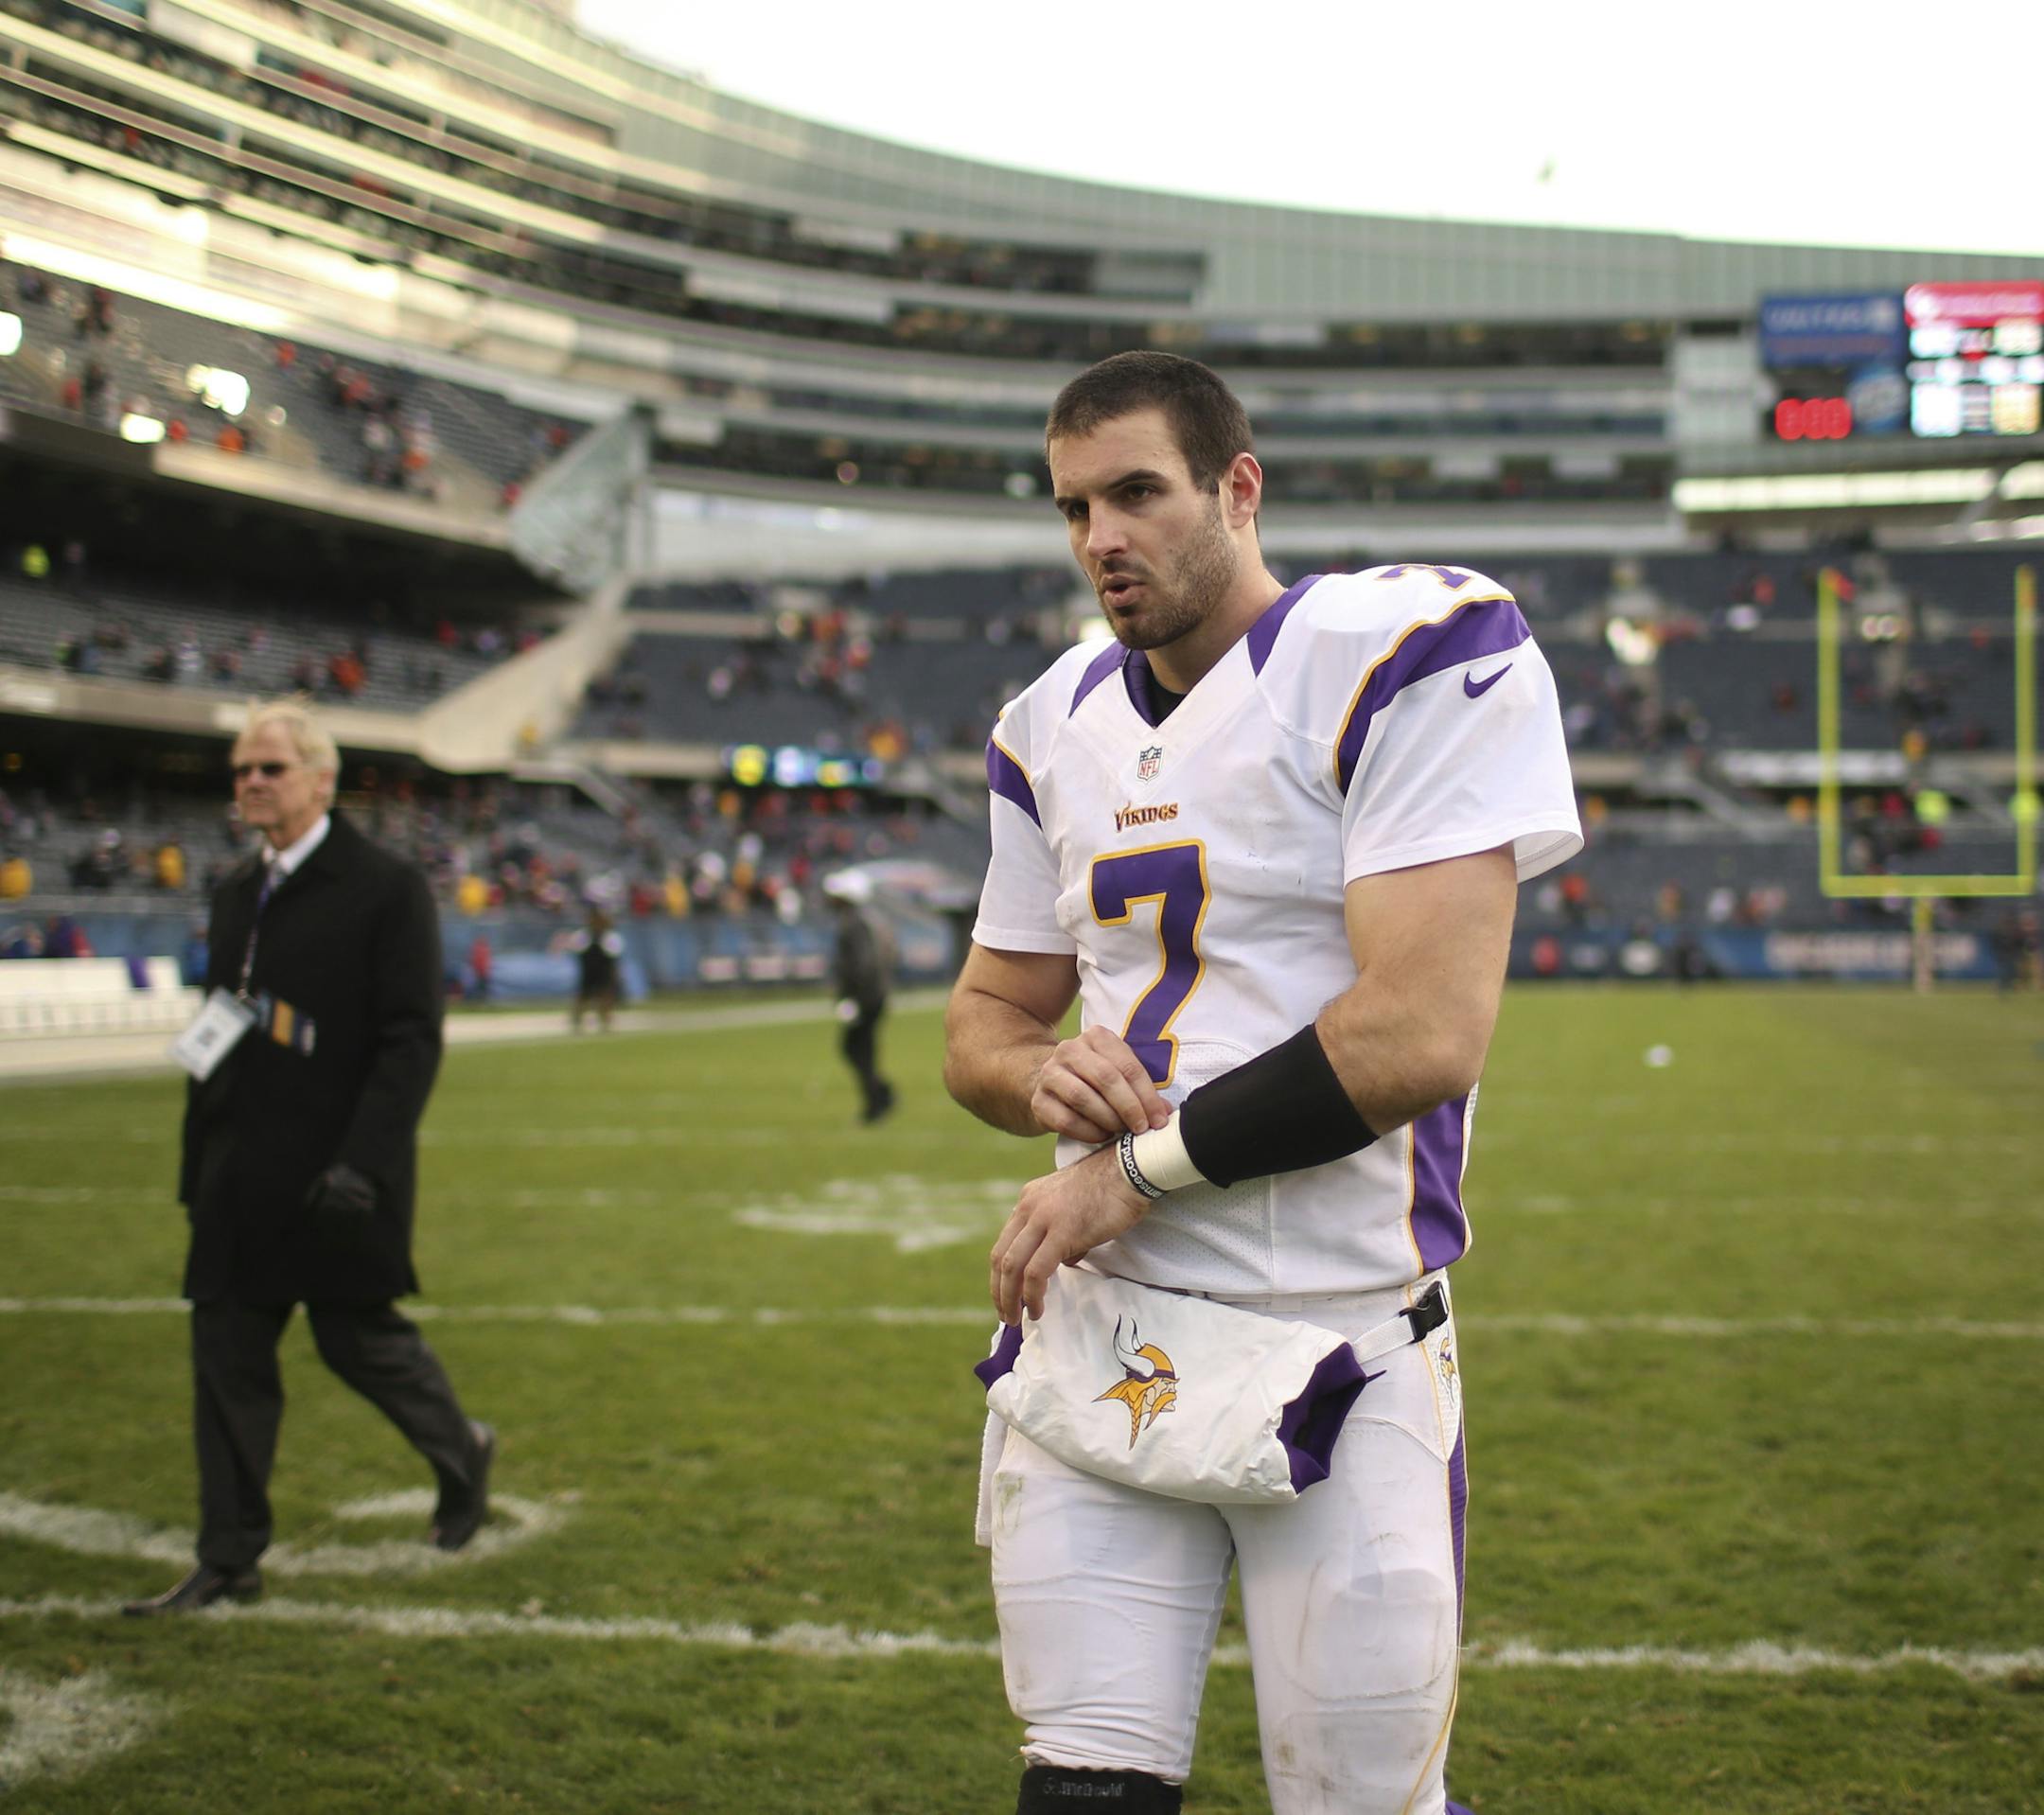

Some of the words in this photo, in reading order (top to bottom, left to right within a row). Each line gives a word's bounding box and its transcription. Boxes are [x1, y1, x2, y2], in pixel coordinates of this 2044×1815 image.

[1139, 761, 1158, 777] NFL
[1115, 802, 1178, 833] VIKINGS
[1088, 838, 1211, 1089] 7
